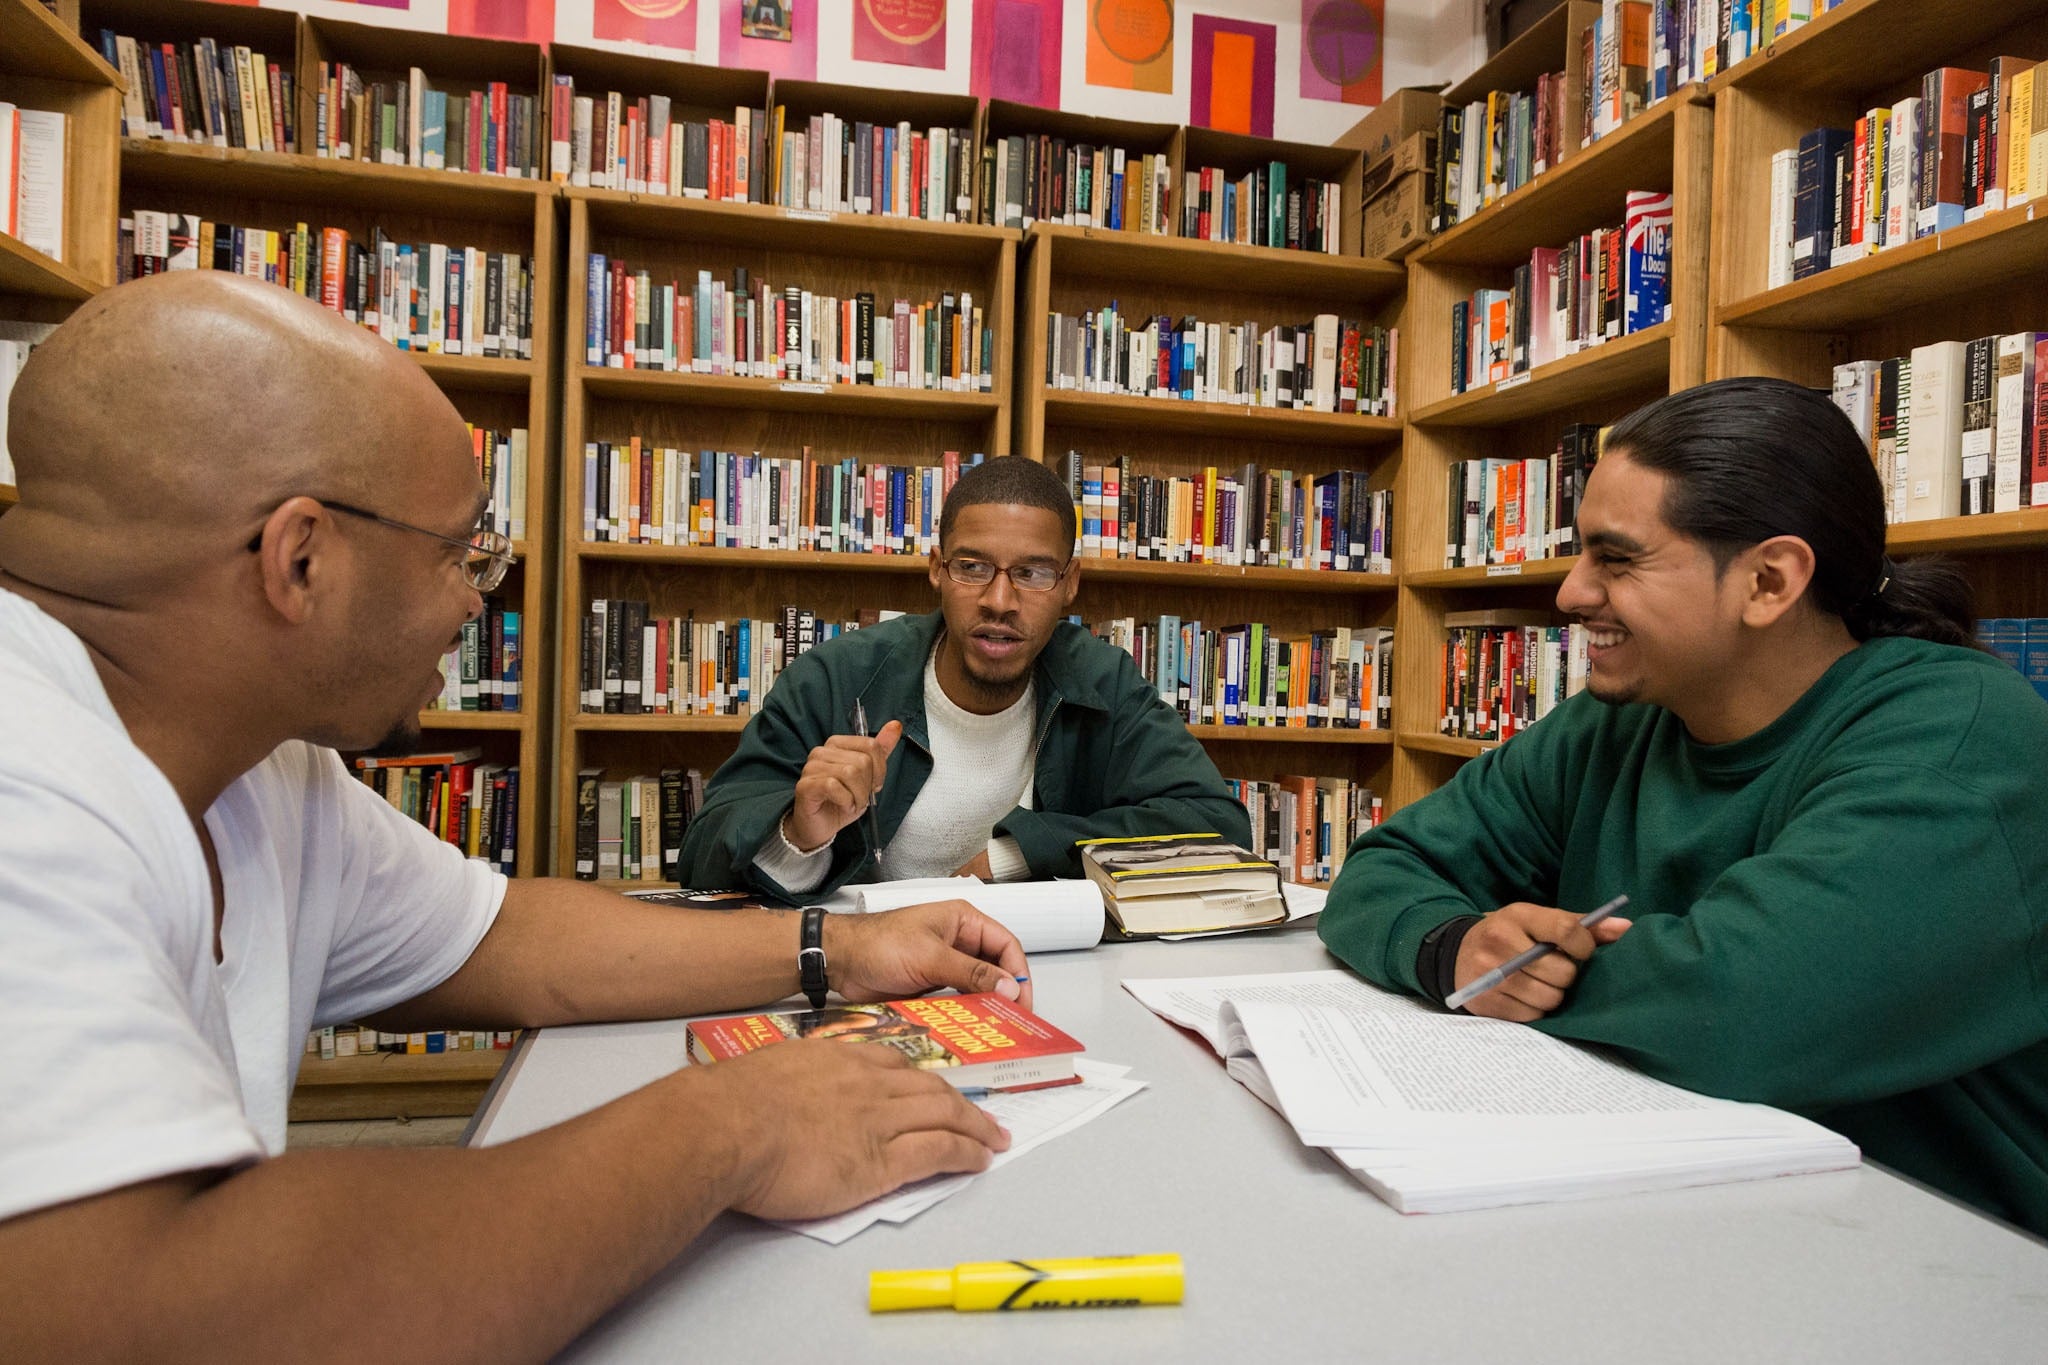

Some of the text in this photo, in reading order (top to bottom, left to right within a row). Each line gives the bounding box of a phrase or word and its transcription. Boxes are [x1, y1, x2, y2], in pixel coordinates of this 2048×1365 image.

[1641, 215, 1664, 256] The
[325, 237, 341, 275] ANIMAL
[1641, 255, 1647, 273] A
[489, 267, 497, 278] City
[1973, 352, 1981, 376] OTHER
[1896, 359, 1911, 455] HOMEFRONT
[2037, 382, 2048, 468] ALL GOD'S DANGERS
[1073, 454, 1081, 482] HOMER
[906, 474, 915, 502] CRUDDY
[1294, 529, 1304, 545] Open
[1295, 518, 1305, 529] The
[786, 607, 797, 654] CHANG-RAE LEE
[764, 647, 773, 664] LOLITA
[1479, 652, 1487, 686] PALESTINIAN
[1528, 641, 1537, 695] CHOOSING WAR
[1382, 666, 1390, 697] STANNARD
[480, 778, 494, 838] EINSTEIN PICASSO
[743, 1016, 775, 1042] WILL
[902, 1000, 993, 1055] REVOLUTION
[932, 999, 980, 1025] GOOD
[965, 1022, 1017, 1048] FOOD
